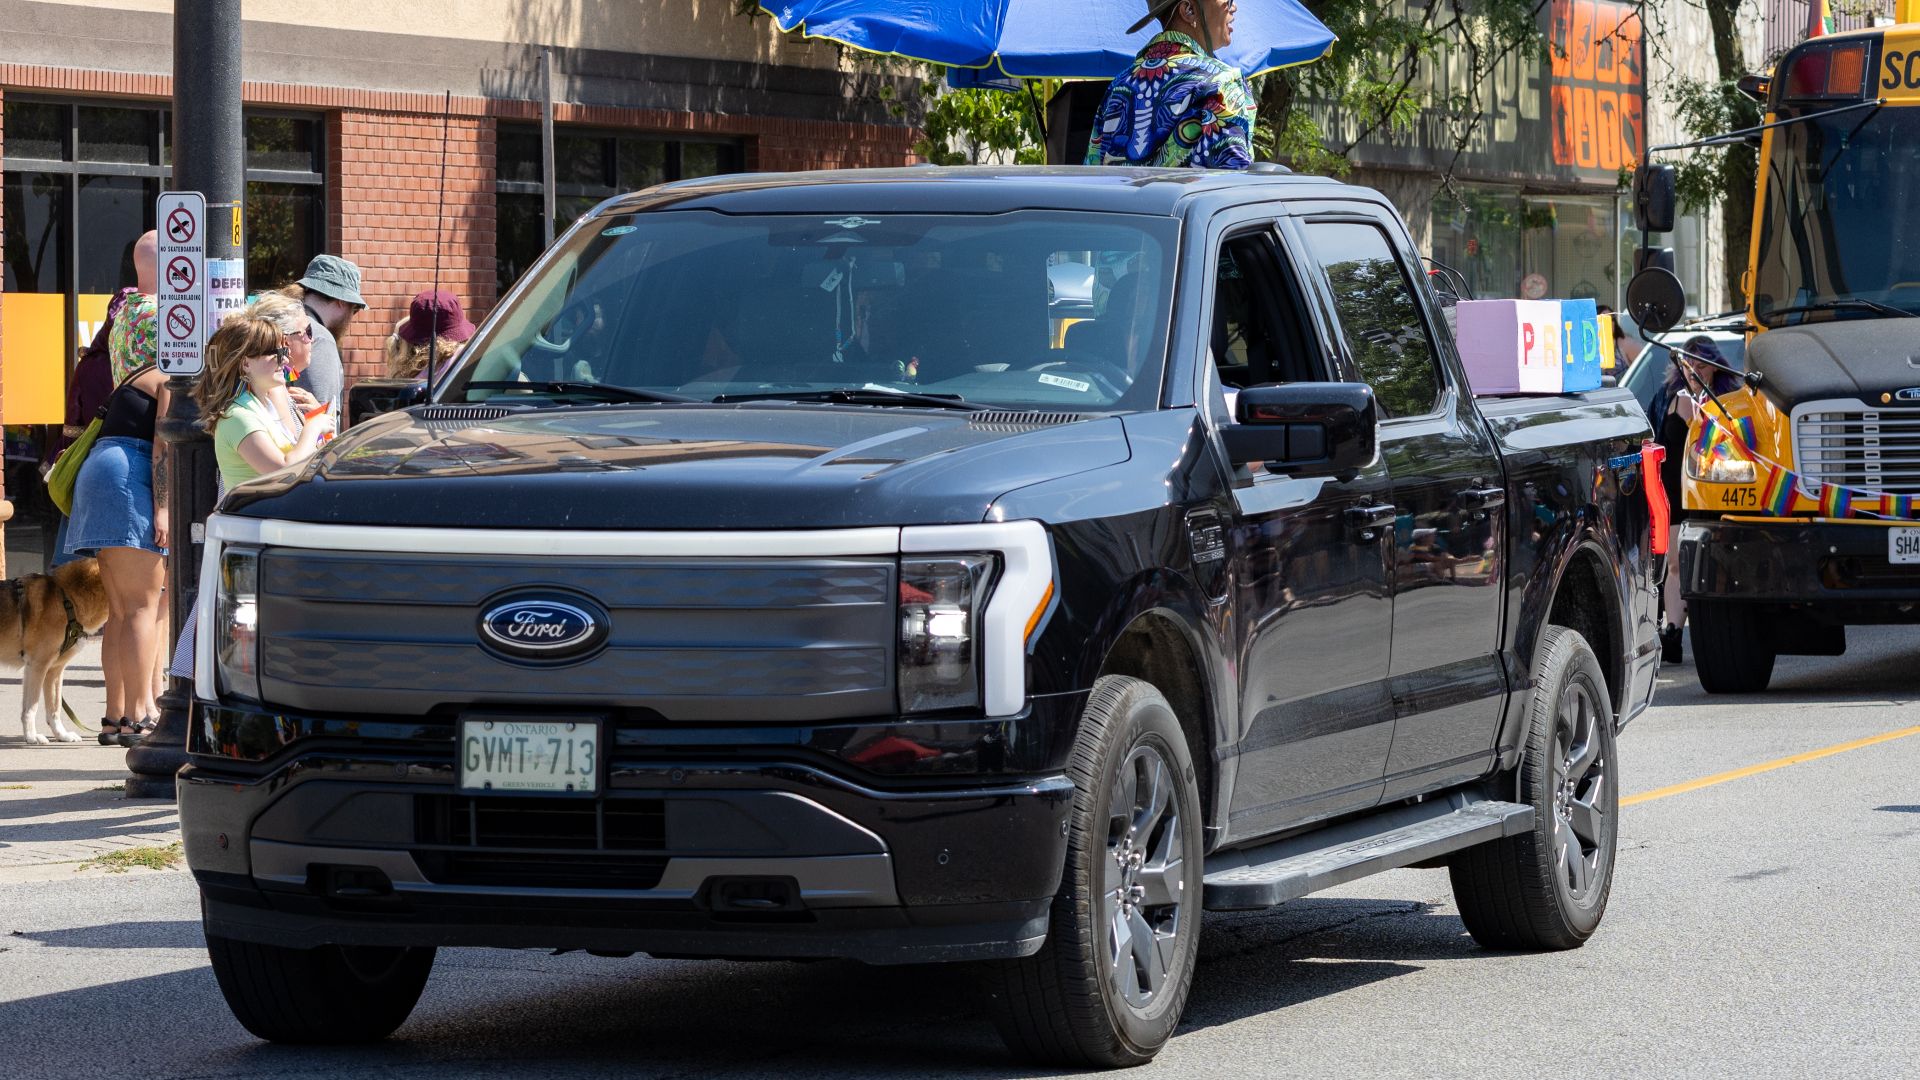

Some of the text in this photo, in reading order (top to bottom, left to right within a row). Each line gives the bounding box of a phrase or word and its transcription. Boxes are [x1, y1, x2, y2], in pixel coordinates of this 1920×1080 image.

[1338, 104, 1360, 145] FOR
[160, 245, 202, 253] NO SKATEBOARDING
[161, 351, 169, 359] ON
[1721, 487, 1757, 507] 4475
[507, 610, 567, 638] Ford
[465, 736, 595, 776] GVMT 713
